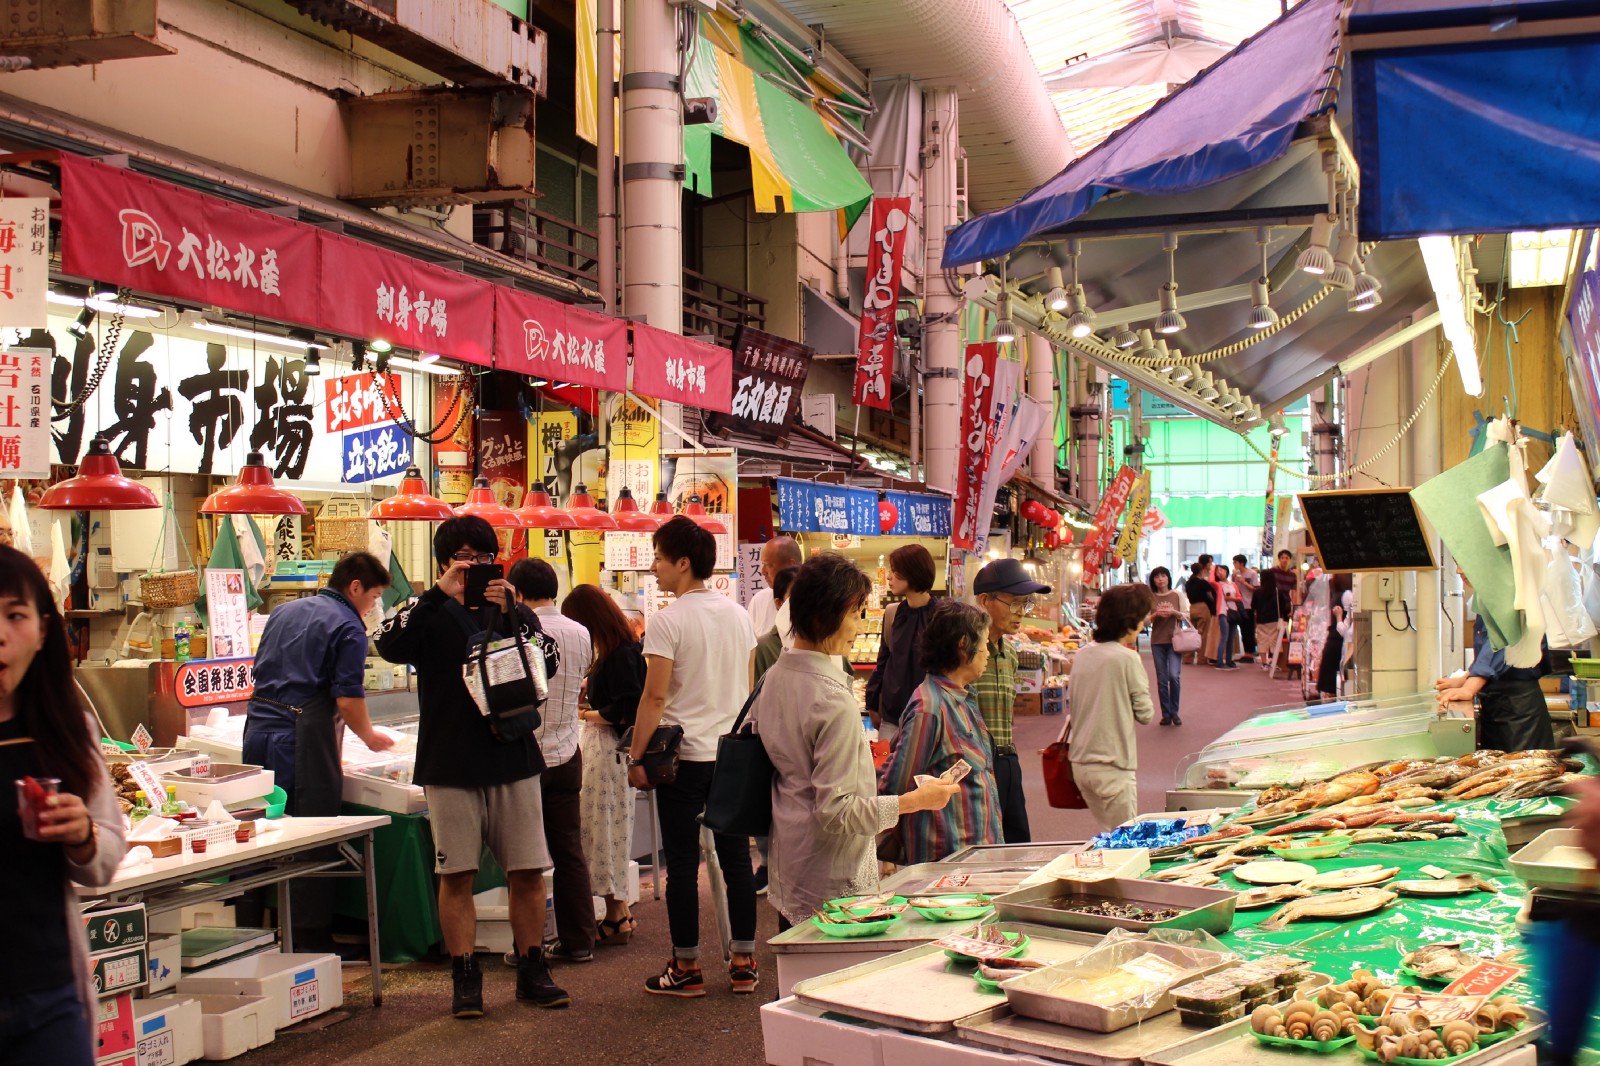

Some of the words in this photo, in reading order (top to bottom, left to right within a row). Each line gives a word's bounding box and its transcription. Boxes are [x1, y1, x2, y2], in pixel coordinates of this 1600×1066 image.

[30, 207, 45, 256] お刺身
[178, 227, 281, 297] 大松水産
[376, 281, 448, 338] 刺身市場
[31, 356, 41, 378] 天然
[551, 328, 606, 374] 大松水産
[665, 356, 706, 394] 刺身市場
[30, 384, 41, 428] 石川県産
[330, 373, 399, 431] 立ち喰い
[612, 405, 652, 424] Asahi
[732, 375, 792, 425] 石丸食品
[346, 428, 411, 480] 立ち飲み
[635, 463, 649, 511] お刺身
[275, 517, 296, 561] 能登
[824, 508, 849, 530] 石丸食品
[1382, 578, 1389, 586] 7
[137, 734, 148, 750] 500
[195, 766, 207, 775] 400
[147, 1035, 169, 1050] ゴミ入れ
